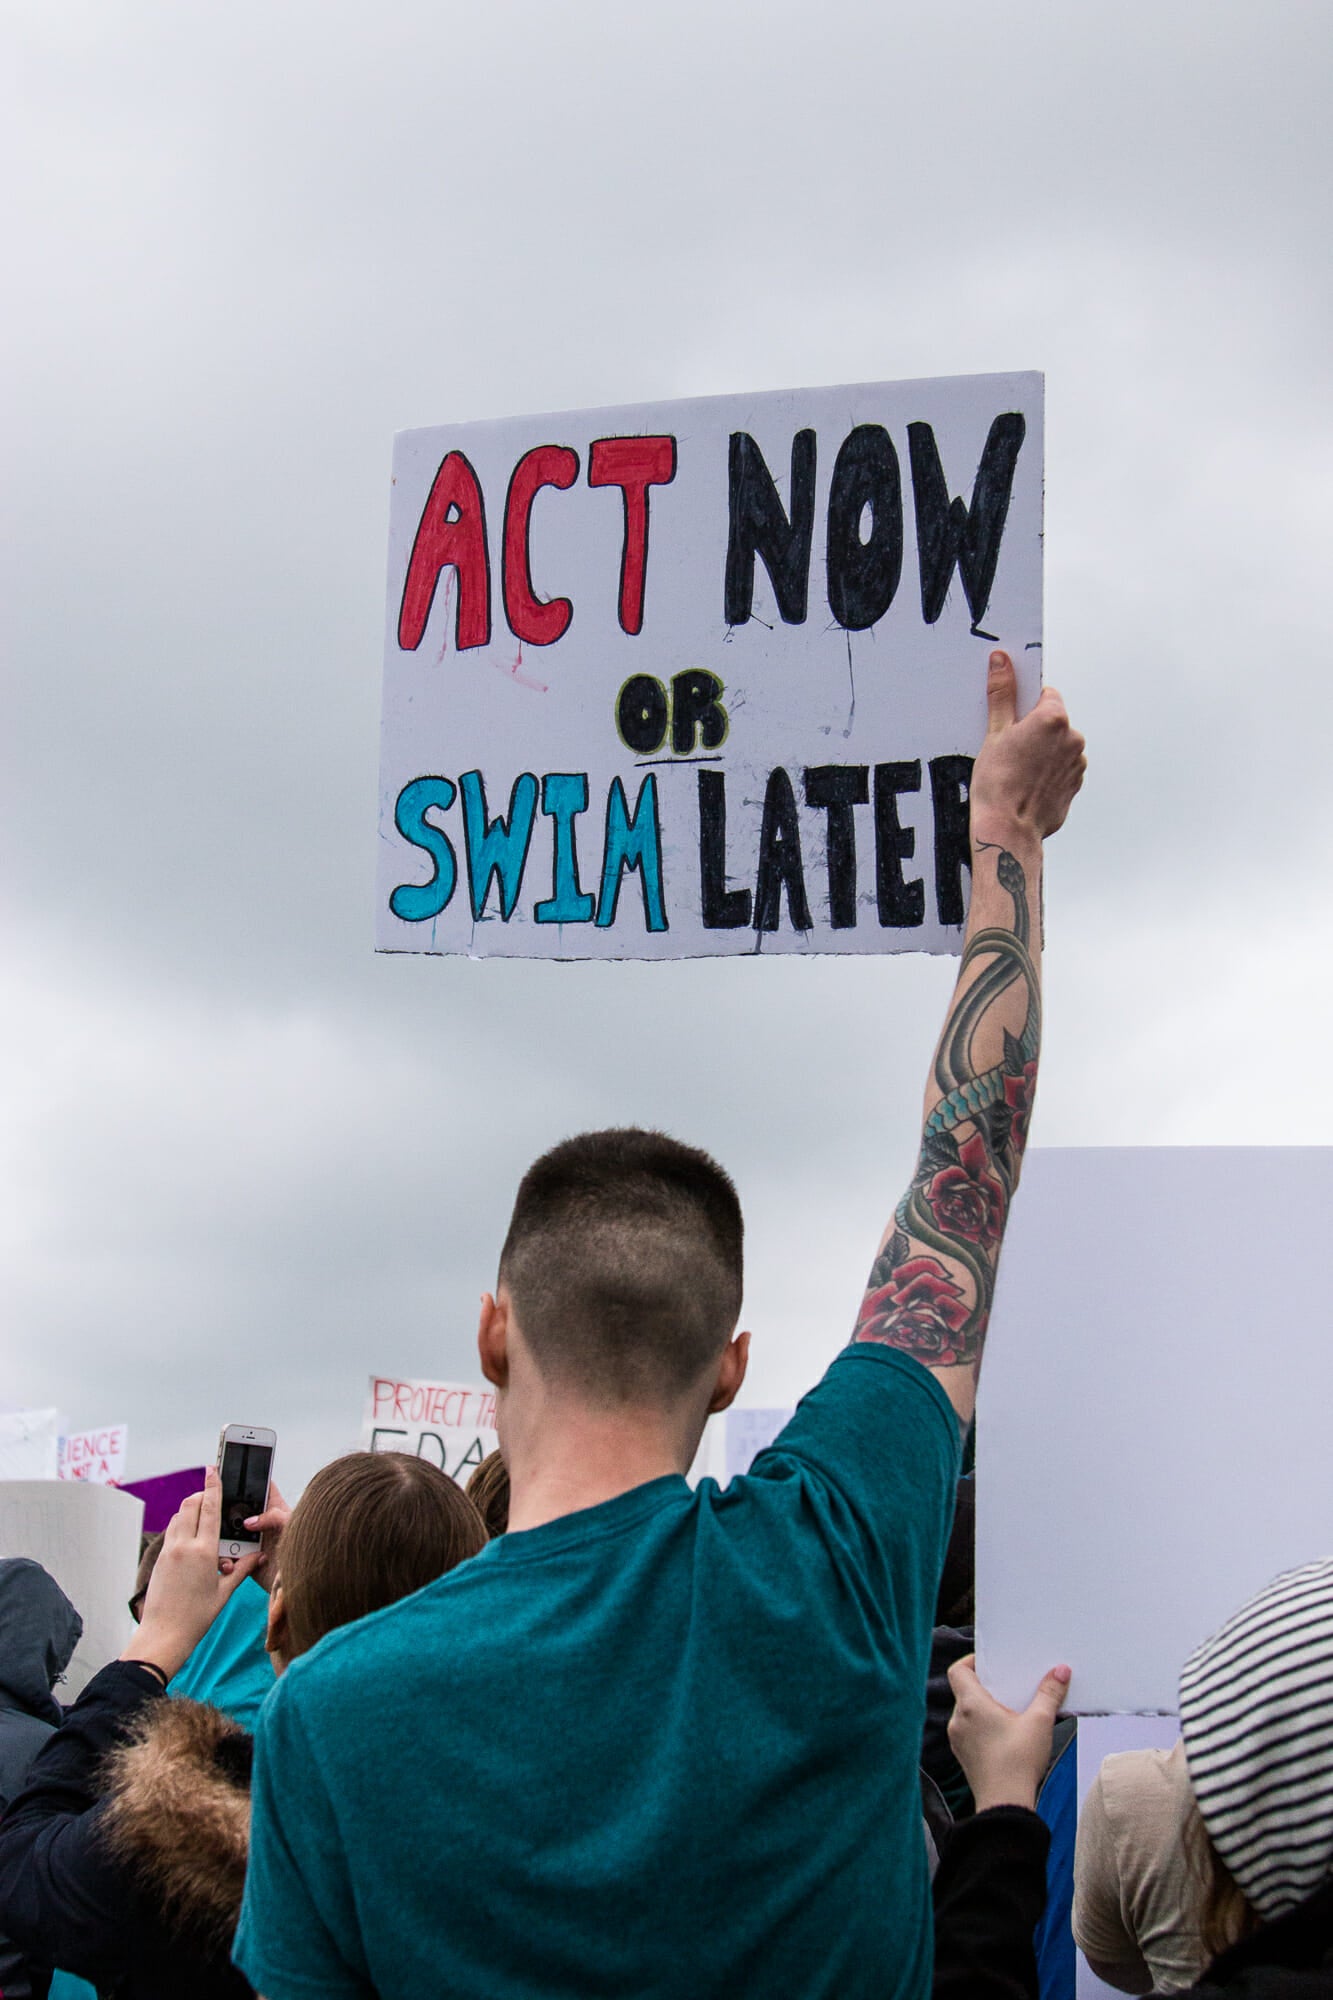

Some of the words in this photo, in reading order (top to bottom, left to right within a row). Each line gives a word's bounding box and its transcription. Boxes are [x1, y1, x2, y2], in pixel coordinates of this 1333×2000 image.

[398, 435, 677, 651] ACT
[724, 412, 1025, 634] NOW
[615, 668, 728, 755] OR
[389, 770, 669, 931] SWIM
[697, 755, 976, 930] LATER
[373, 1379, 472, 1427] PROTECT
